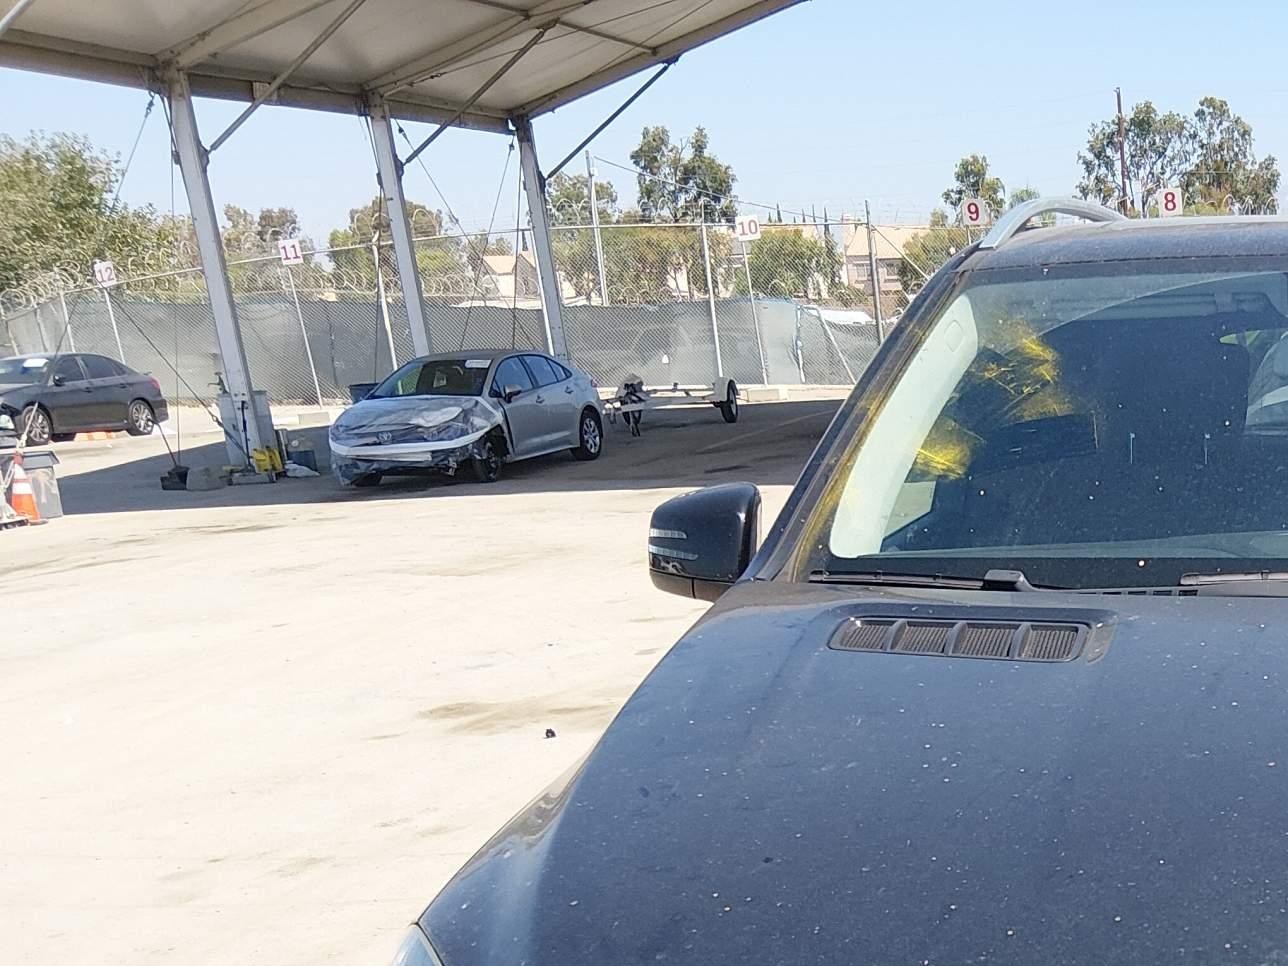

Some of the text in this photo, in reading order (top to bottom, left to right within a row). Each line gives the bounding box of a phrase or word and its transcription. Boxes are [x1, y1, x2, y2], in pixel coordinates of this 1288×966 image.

[1164, 191, 1177, 211] 8
[967, 202, 980, 222] 9
[738, 219, 758, 236] 10
[280, 244, 302, 261] 11
[97, 266, 115, 283] 12
